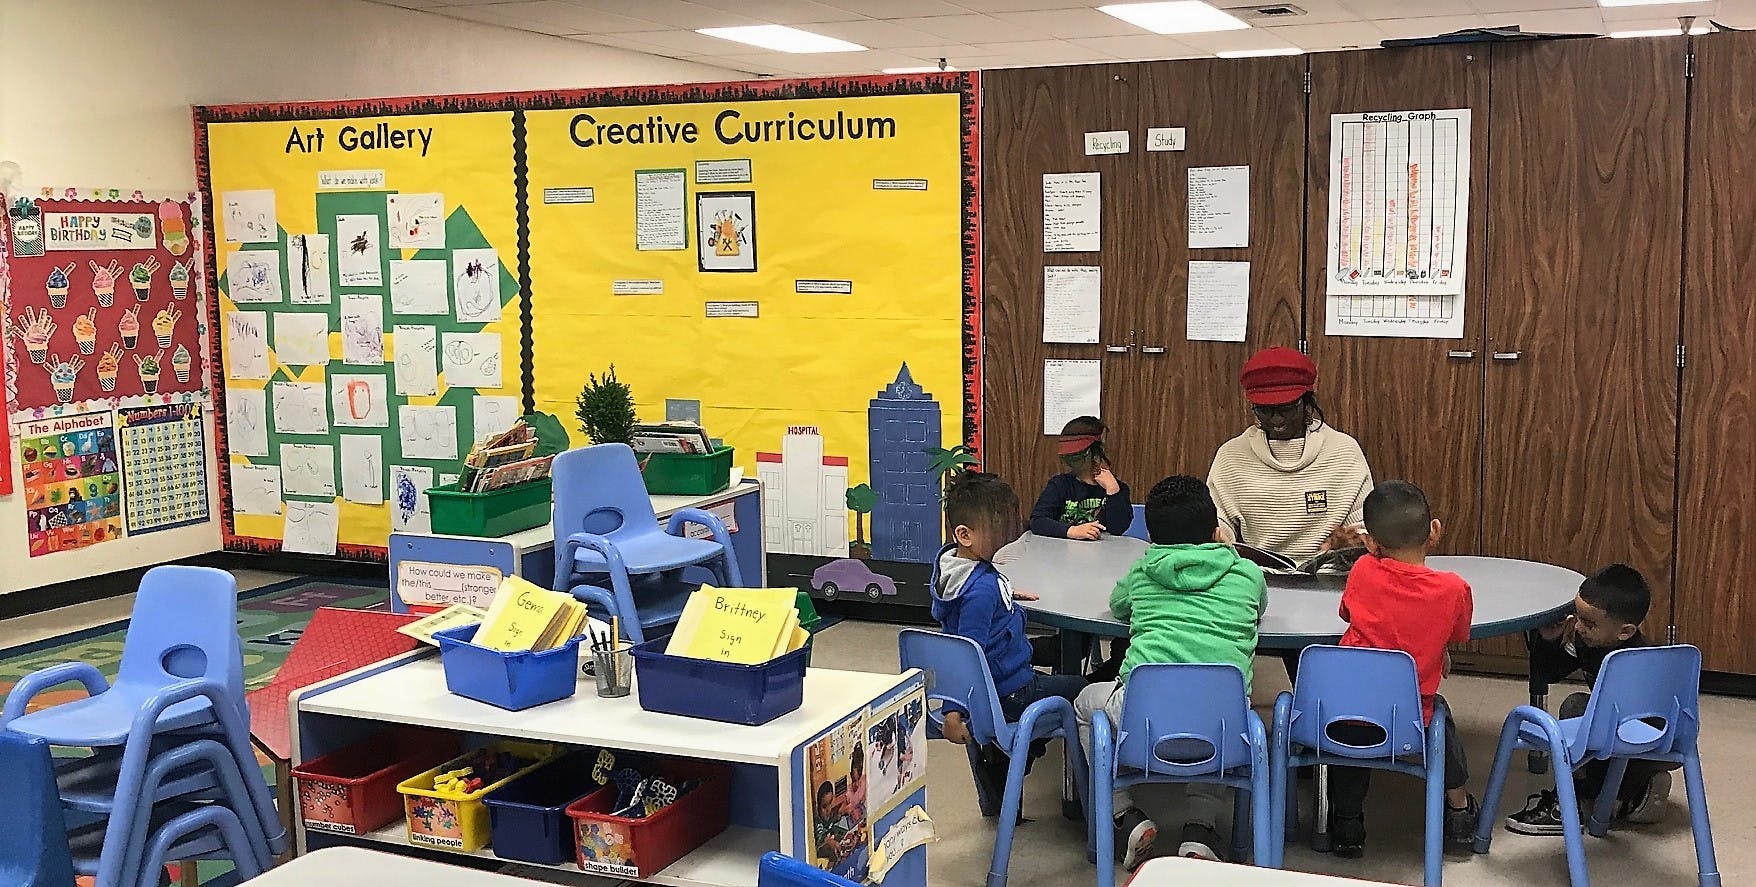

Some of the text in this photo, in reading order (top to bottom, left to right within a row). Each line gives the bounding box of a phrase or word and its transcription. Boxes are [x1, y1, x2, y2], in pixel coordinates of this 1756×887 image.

[1363, 112, 1436, 122] Recycling Graph
[570, 109, 896, 147] Creative Curriculum
[286, 123, 432, 157] Art Gallery
[1092, 136, 1122, 152] Recycling
[1155, 133, 1176, 148] Study
[127, 408, 167, 422] Numbers
[29, 416, 104, 434] The Alphabet
[788, 426, 819, 436] HOSPITAL
[409, 567, 427, 576] How
[429, 568, 451, 578] could
[467, 572, 491, 581] make
[402, 578, 432, 589] the/this
[715, 596, 767, 623] Brittney
[721, 648, 730, 658] in
[306, 821, 354, 832] number cubes
[412, 834, 462, 848] linking people
[585, 862, 637, 875] shape builder
